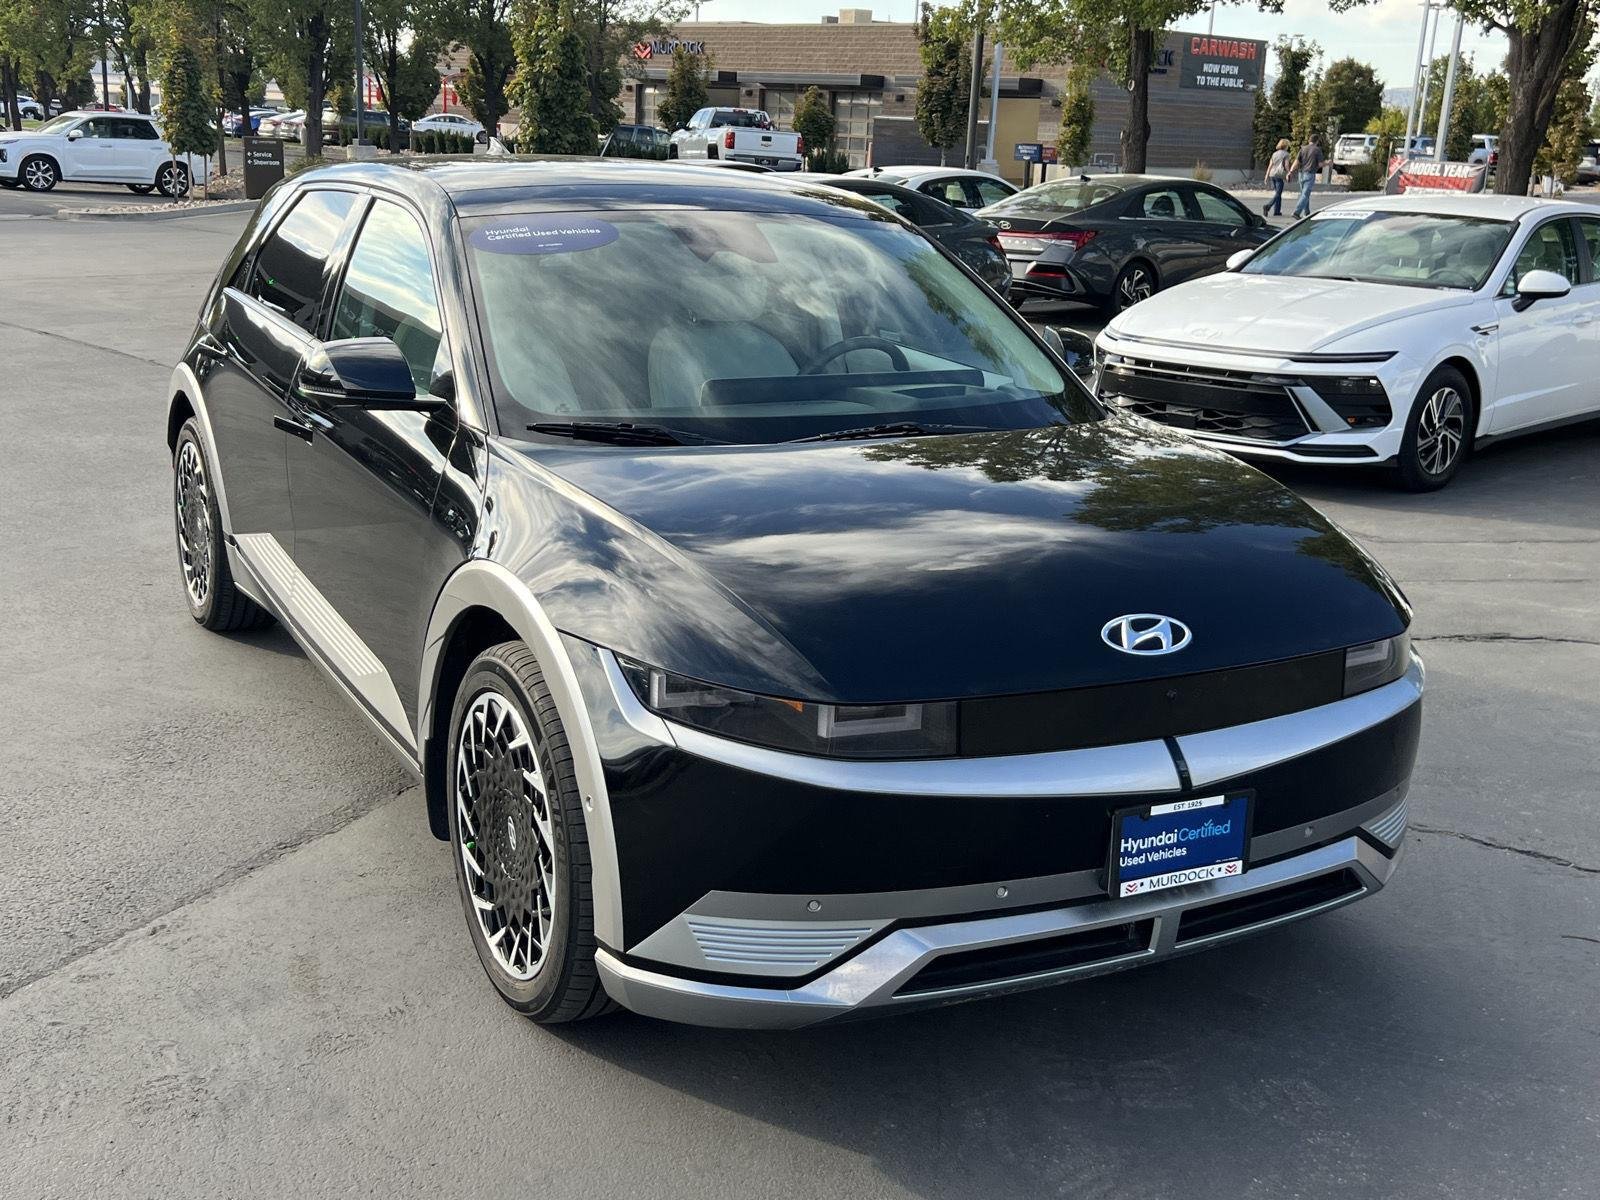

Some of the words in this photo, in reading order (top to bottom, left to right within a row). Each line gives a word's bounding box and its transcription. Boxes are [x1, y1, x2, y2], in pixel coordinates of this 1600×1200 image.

[1191, 37, 1257, 59] CARWASH
[1203, 63, 1220, 74] NOW
[1221, 65, 1239, 75] OPEN
[1196, 76, 1206, 86] TO
[1207, 76, 1220, 87] THE
[1220, 78, 1244, 89] PUBLIC
[1408, 162, 1441, 177] MODEL
[1443, 164, 1471, 179] YEAR
[485, 226, 529, 235] Hyundai
[487, 231, 531, 241] Certified
[1188, 800, 1203, 808] 1925
[1120, 829, 1178, 853] Hyundai
[1178, 818, 1231, 842] Certified
[1120, 853, 1146, 867] Used
[1146, 846, 1187, 863] Vehicles
[1149, 867, 1215, 889] MURDOCK
